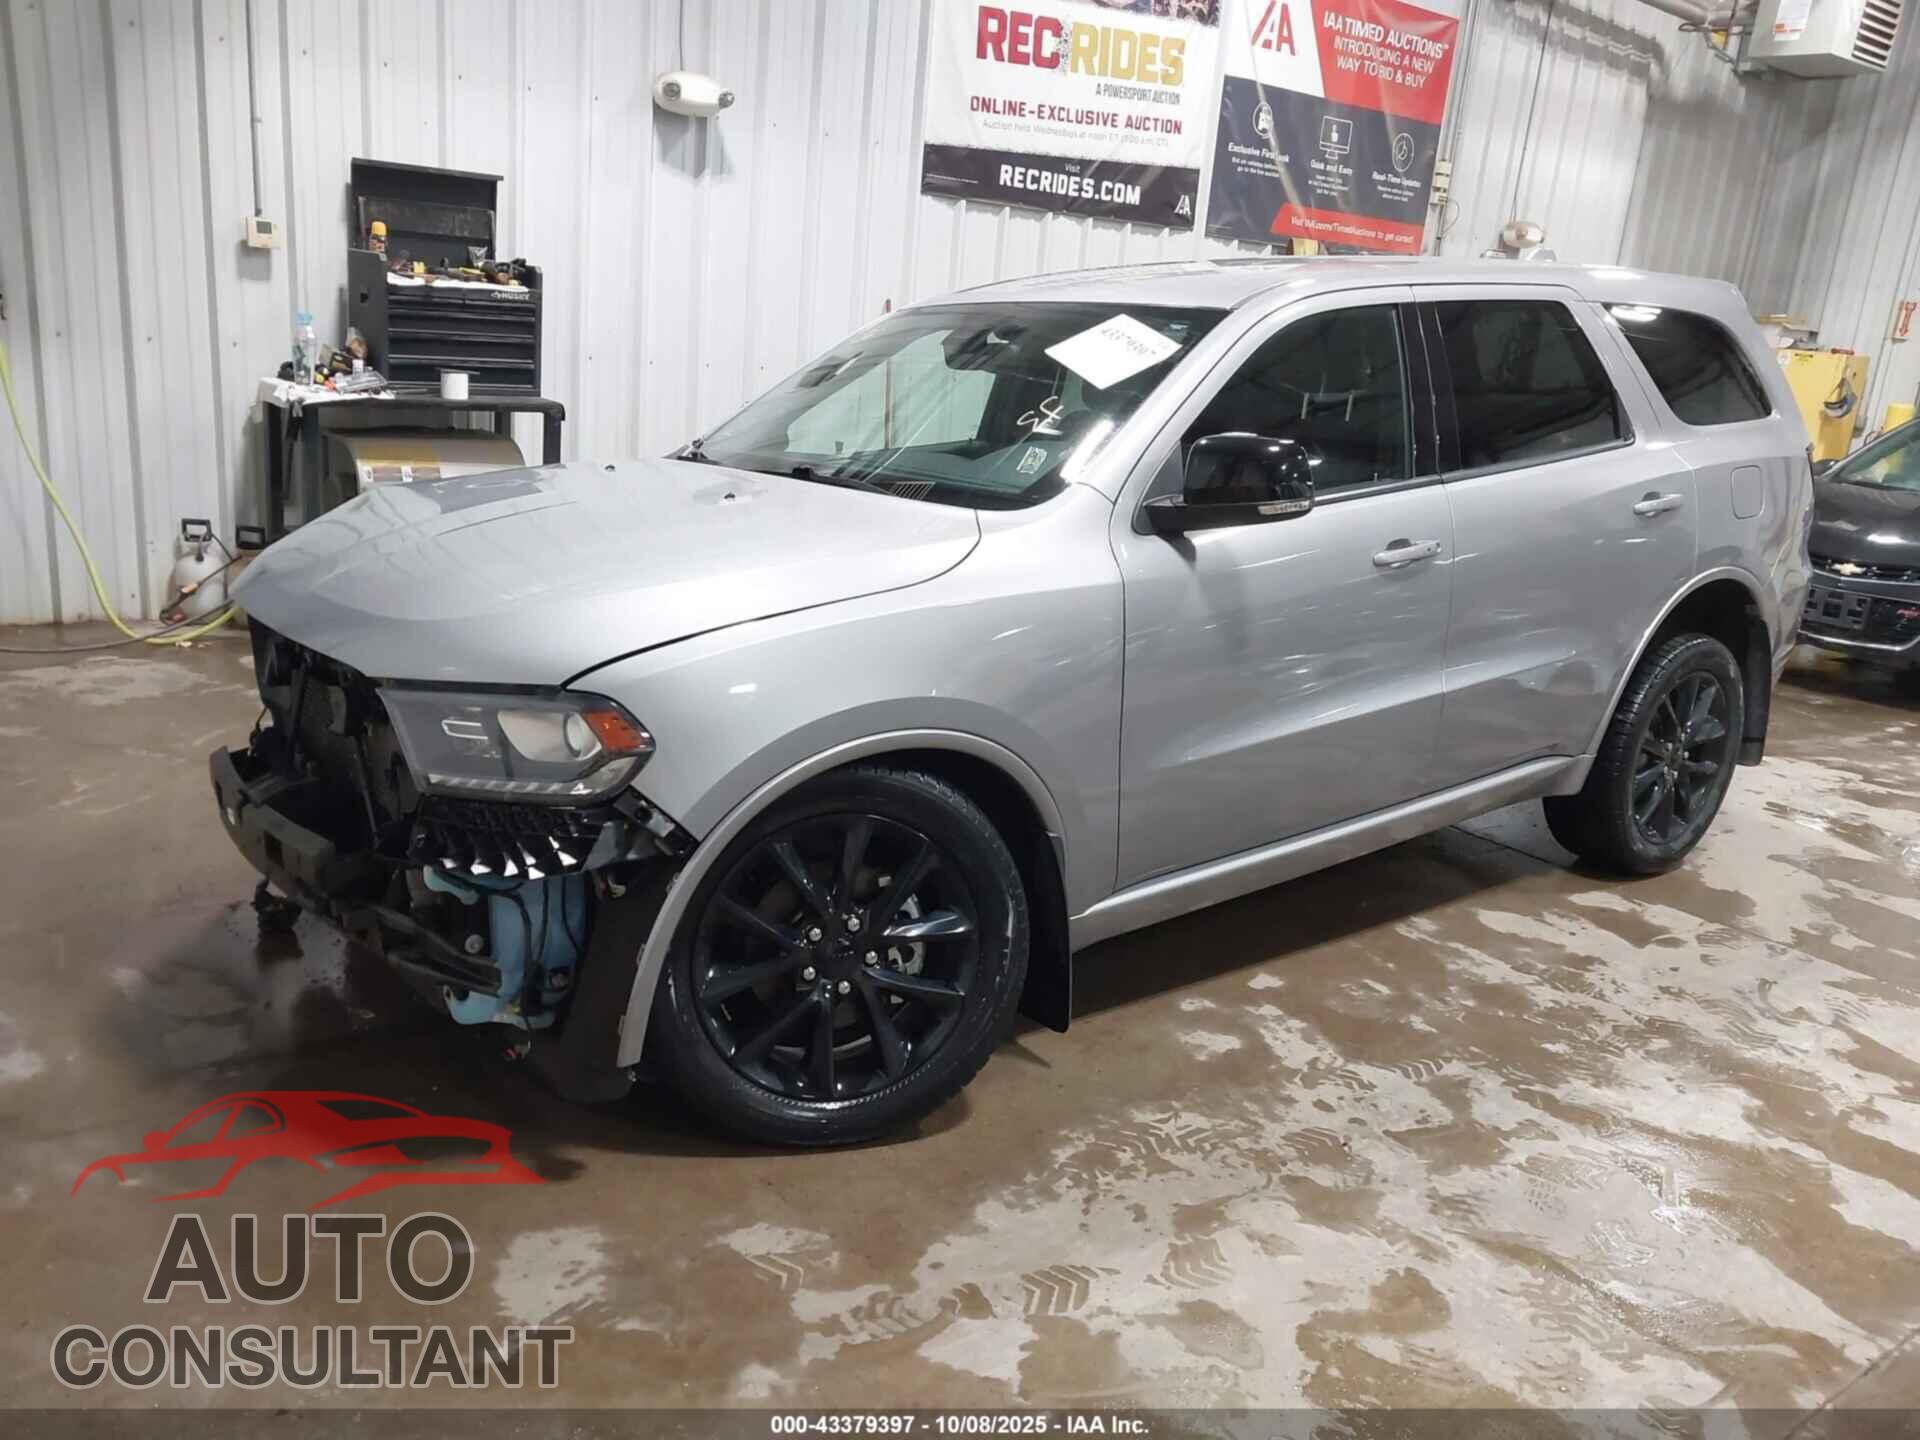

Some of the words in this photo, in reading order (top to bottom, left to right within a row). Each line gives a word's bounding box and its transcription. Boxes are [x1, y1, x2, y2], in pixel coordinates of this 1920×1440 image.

[1323, 10, 1342, 32] IAA
[1345, 17, 1384, 42] TIMED
[976, 5, 1063, 70] REC
[1070, 22, 1186, 87] RIDES
[1333, 35, 1401, 65] INTRODUCING
[1402, 55, 1410, 66] A
[1411, 56, 1435, 73] NEW
[1336, 55, 1362, 72] WAY
[1364, 60, 1378, 76] TO
[1379, 66, 1394, 81] BID
[1395, 70, 1403, 84] &
[1405, 72, 1427, 88] BUY
[1096, 83, 1101, 96] A
[1103, 84, 1152, 102] POWERSPORT
[1152, 92, 1180, 105] AUCTION
[970, 95, 1119, 128] ONLINE-EXCLUSIVE
[1124, 114, 1183, 135] AUCTION
[999, 164, 1141, 205] RECRIDES.COM
[1065, 162, 1081, 173] Visit
